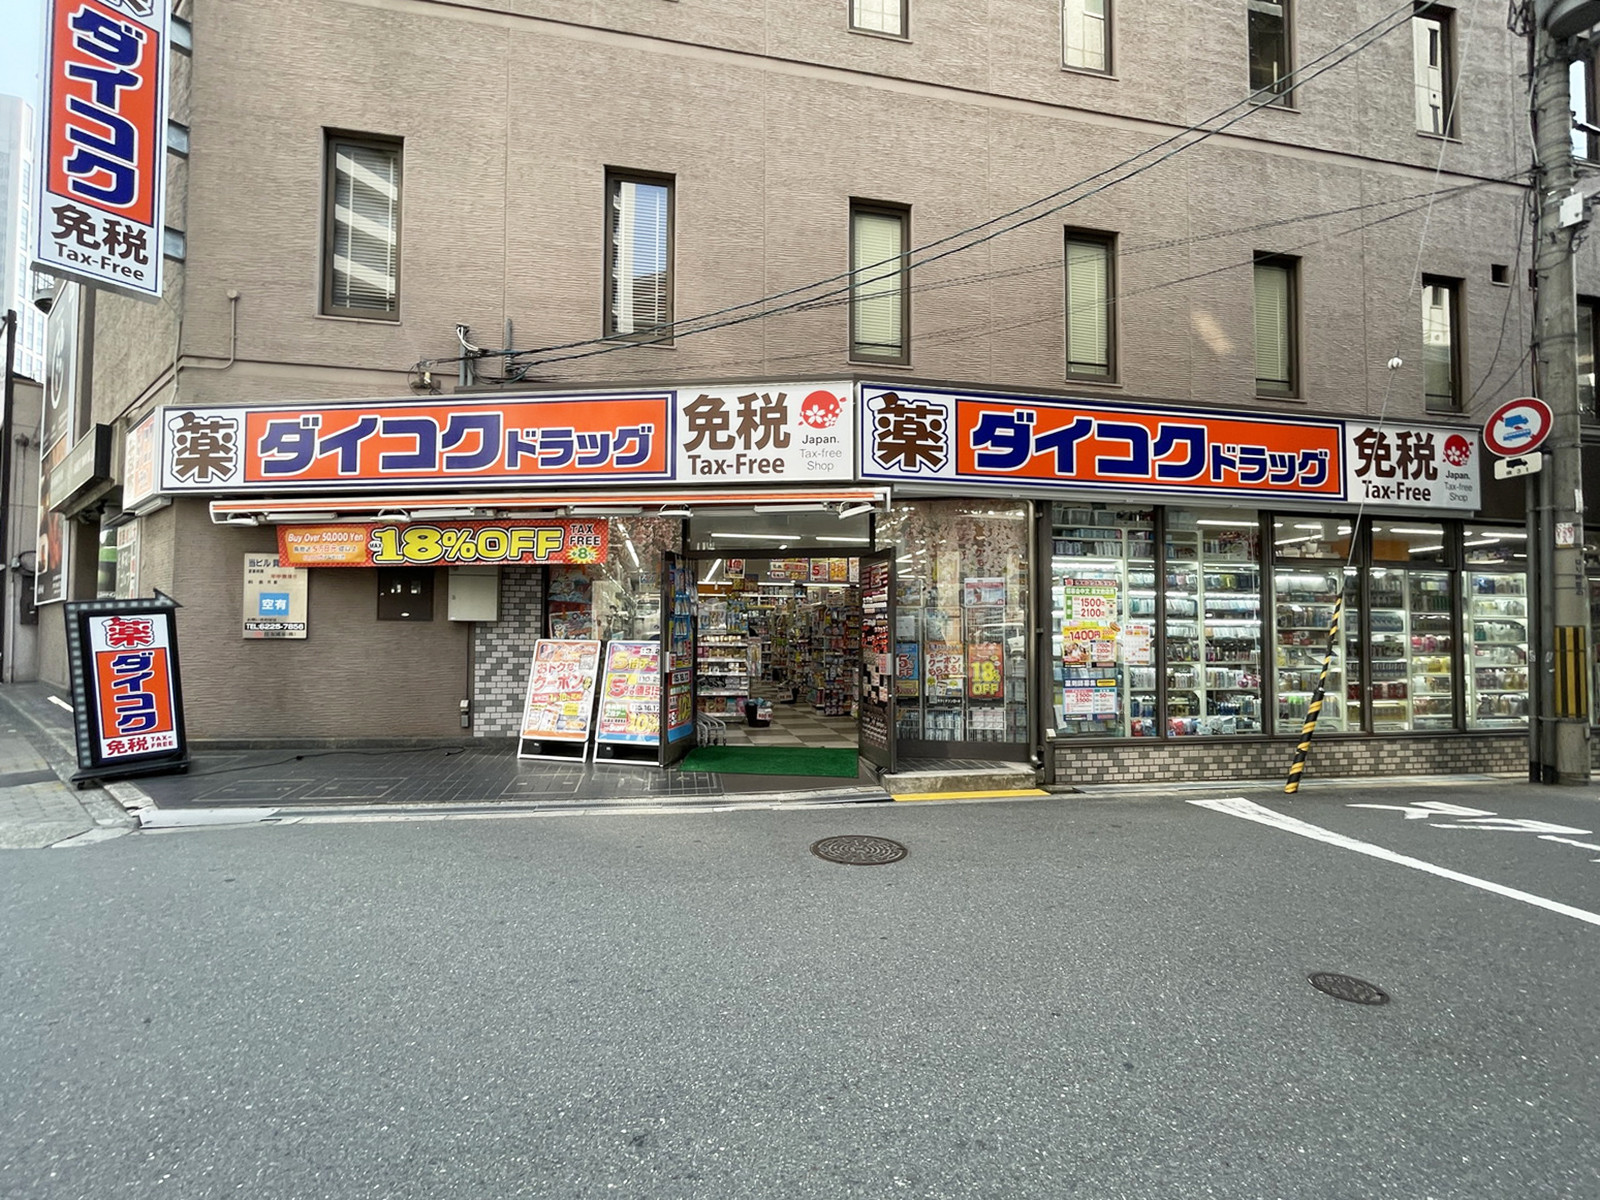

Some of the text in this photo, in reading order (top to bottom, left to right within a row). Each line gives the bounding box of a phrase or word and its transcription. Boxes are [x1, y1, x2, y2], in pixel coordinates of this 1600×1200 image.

[65, 3, 147, 208] ダイコク
[51, 204, 149, 265] 免税
[54, 241, 145, 281] Tax-Free
[683, 393, 791, 453] 免税
[868, 392, 949, 473] 薬
[169, 411, 239, 483] 薬
[800, 447, 843, 459] Tax-free
[1352, 427, 1438, 481] 免税
[687, 453, 785, 475] Tax-Free
[806, 460, 834, 472] Shop
[1362, 480, 1432, 501] Tax-Free
[1444, 481, 1473, 492] Tax-free
[1448, 491, 1469, 502] Shop
[287, 533, 302, 543] Buy
[304, 532, 321, 542] Over
[349, 532, 364, 542] Yen
[571, 524, 594, 534] TAX
[569, 535, 600, 546] FREE
[102, 616, 154, 648] 薬
[111, 651, 158, 734] ダイコク
[534, 674, 584, 691] クーポン
[972, 683, 999, 695] OFF
[106, 736, 149, 756] 免税
